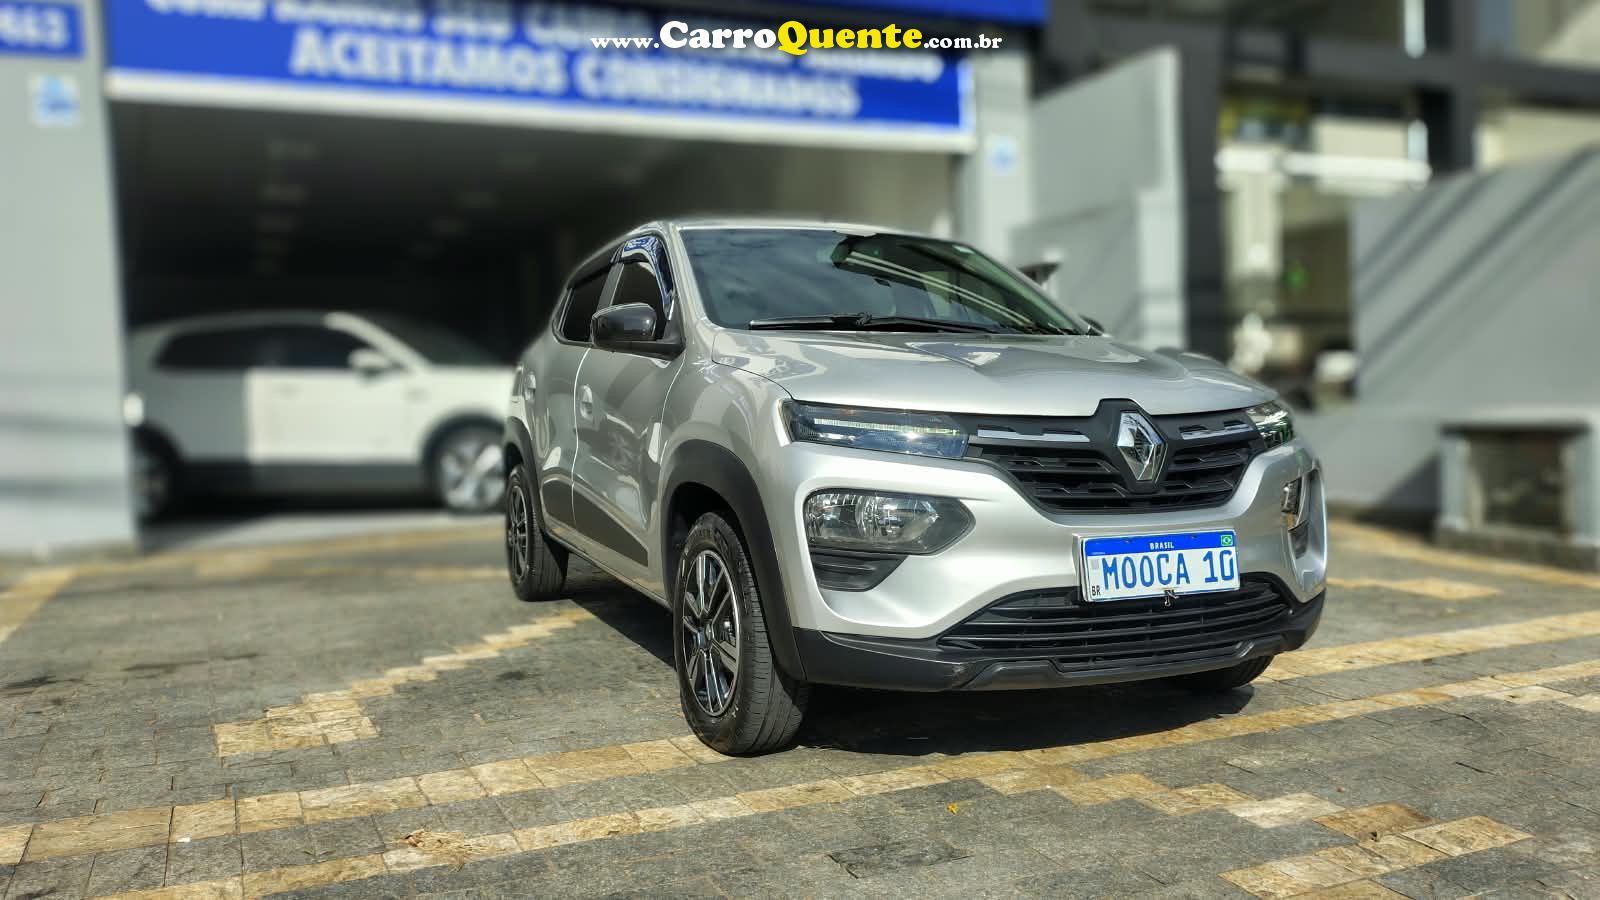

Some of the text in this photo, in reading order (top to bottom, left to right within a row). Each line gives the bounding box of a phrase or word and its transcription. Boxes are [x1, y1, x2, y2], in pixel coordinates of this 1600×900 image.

[1150, 541, 1174, 550] BRASIL
[1102, 549, 1234, 590] MOOCA 10
[1091, 585, 1101, 597] BR
